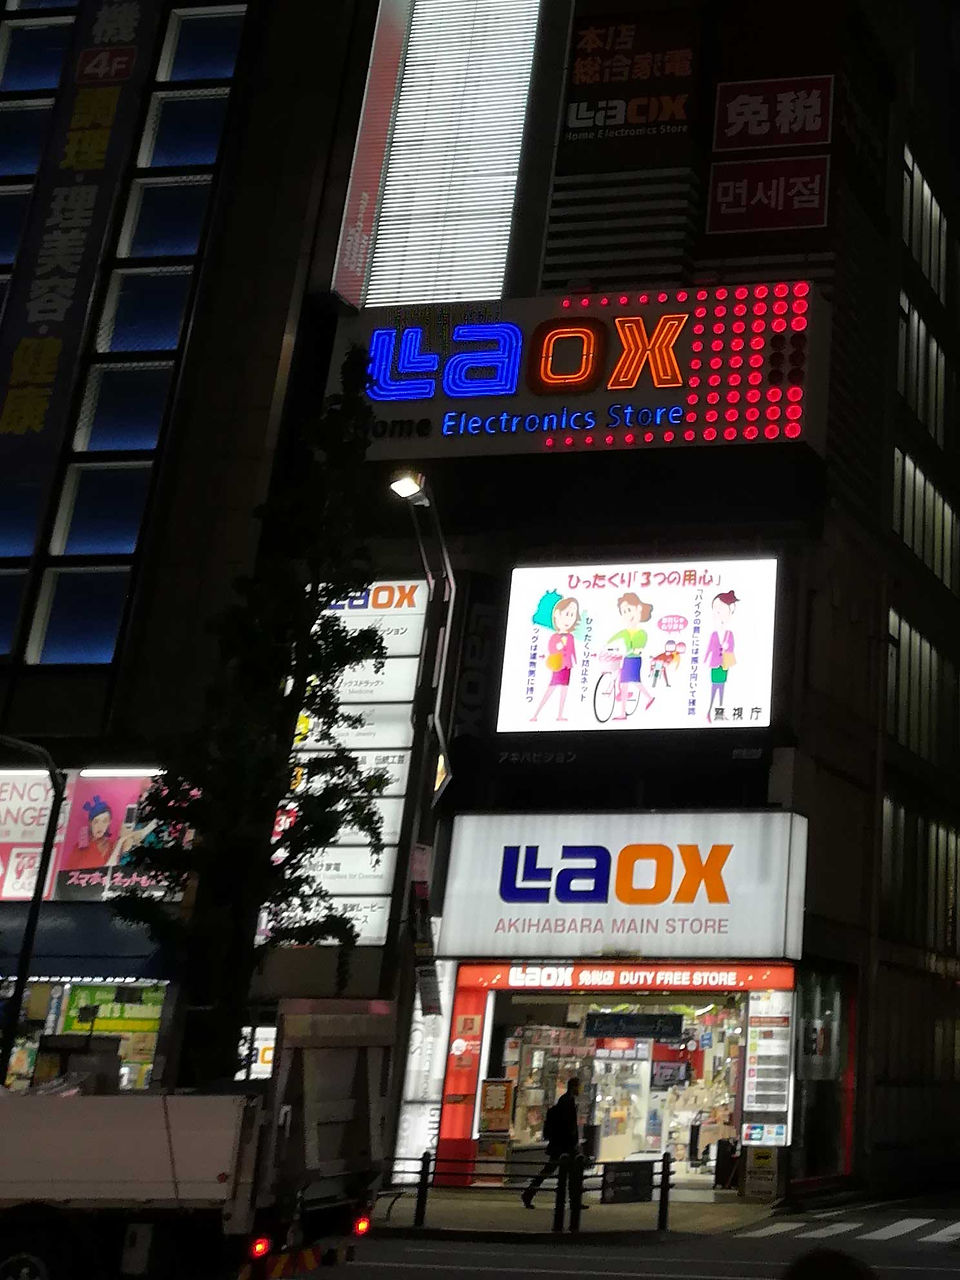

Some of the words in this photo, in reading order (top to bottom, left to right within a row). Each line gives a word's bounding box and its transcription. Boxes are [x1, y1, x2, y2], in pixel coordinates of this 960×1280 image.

[725, 86, 823, 139] 免税
[717, 175, 823, 216] 면세점
[442, 405, 597, 437] Electronics
[608, 403, 685, 428] Store
[494, 918, 605, 935] AKIHABARA
[610, 918, 660, 934] MAIN
[665, 917, 730, 934] STORE
[620, 970, 655, 986] DUTY
[656, 970, 690, 985] FREE
[692, 970, 737, 986] STORE
